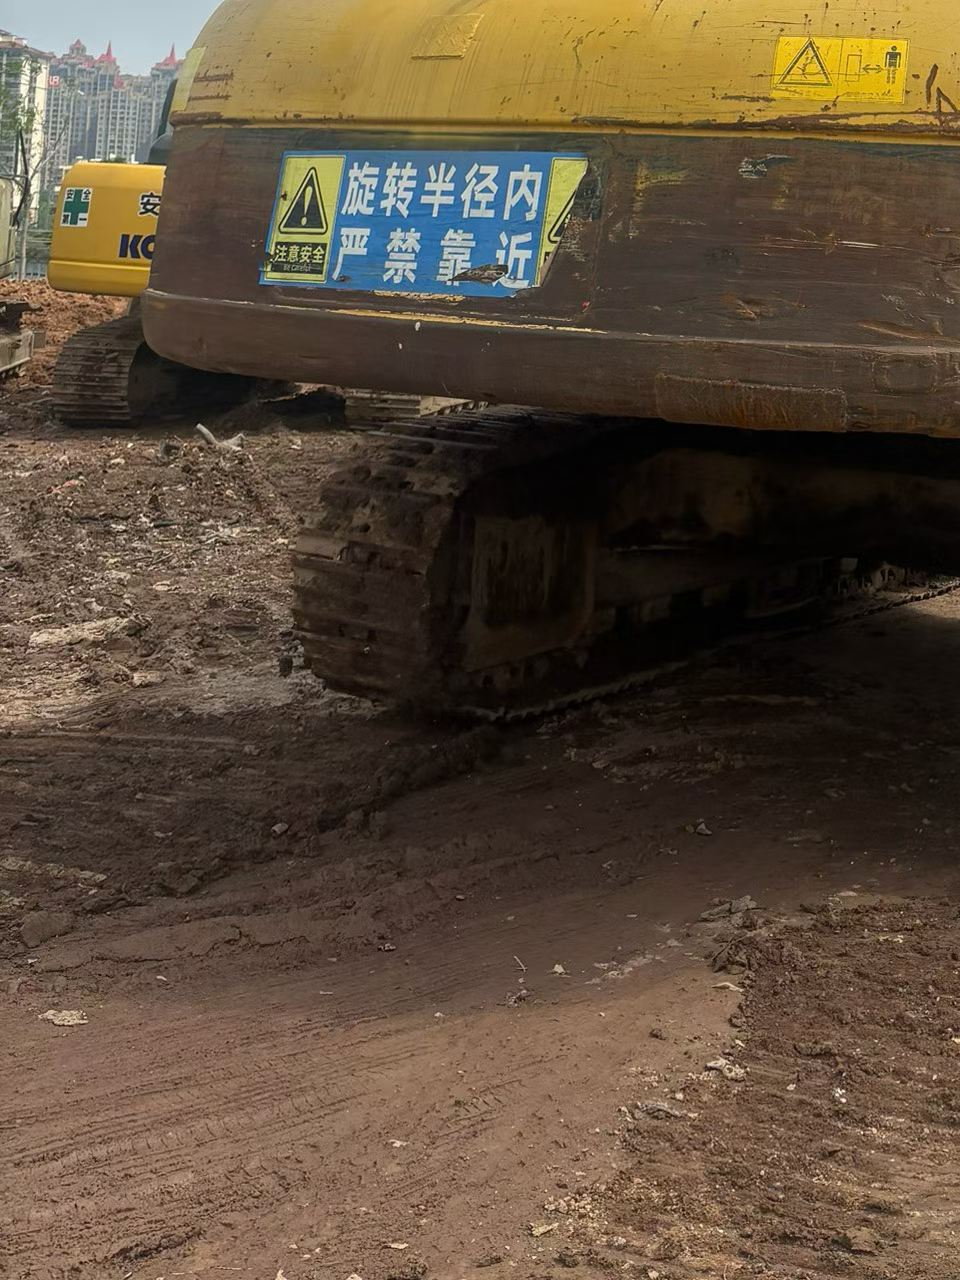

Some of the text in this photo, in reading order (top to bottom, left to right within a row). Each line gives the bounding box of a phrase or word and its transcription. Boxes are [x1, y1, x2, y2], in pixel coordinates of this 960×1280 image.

[138, 192, 161, 217] 安
[341, 162, 543, 221] 旋转半径内
[274, 245, 325, 263] 注意安全
[332, 227, 532, 289] 严禁靠近
